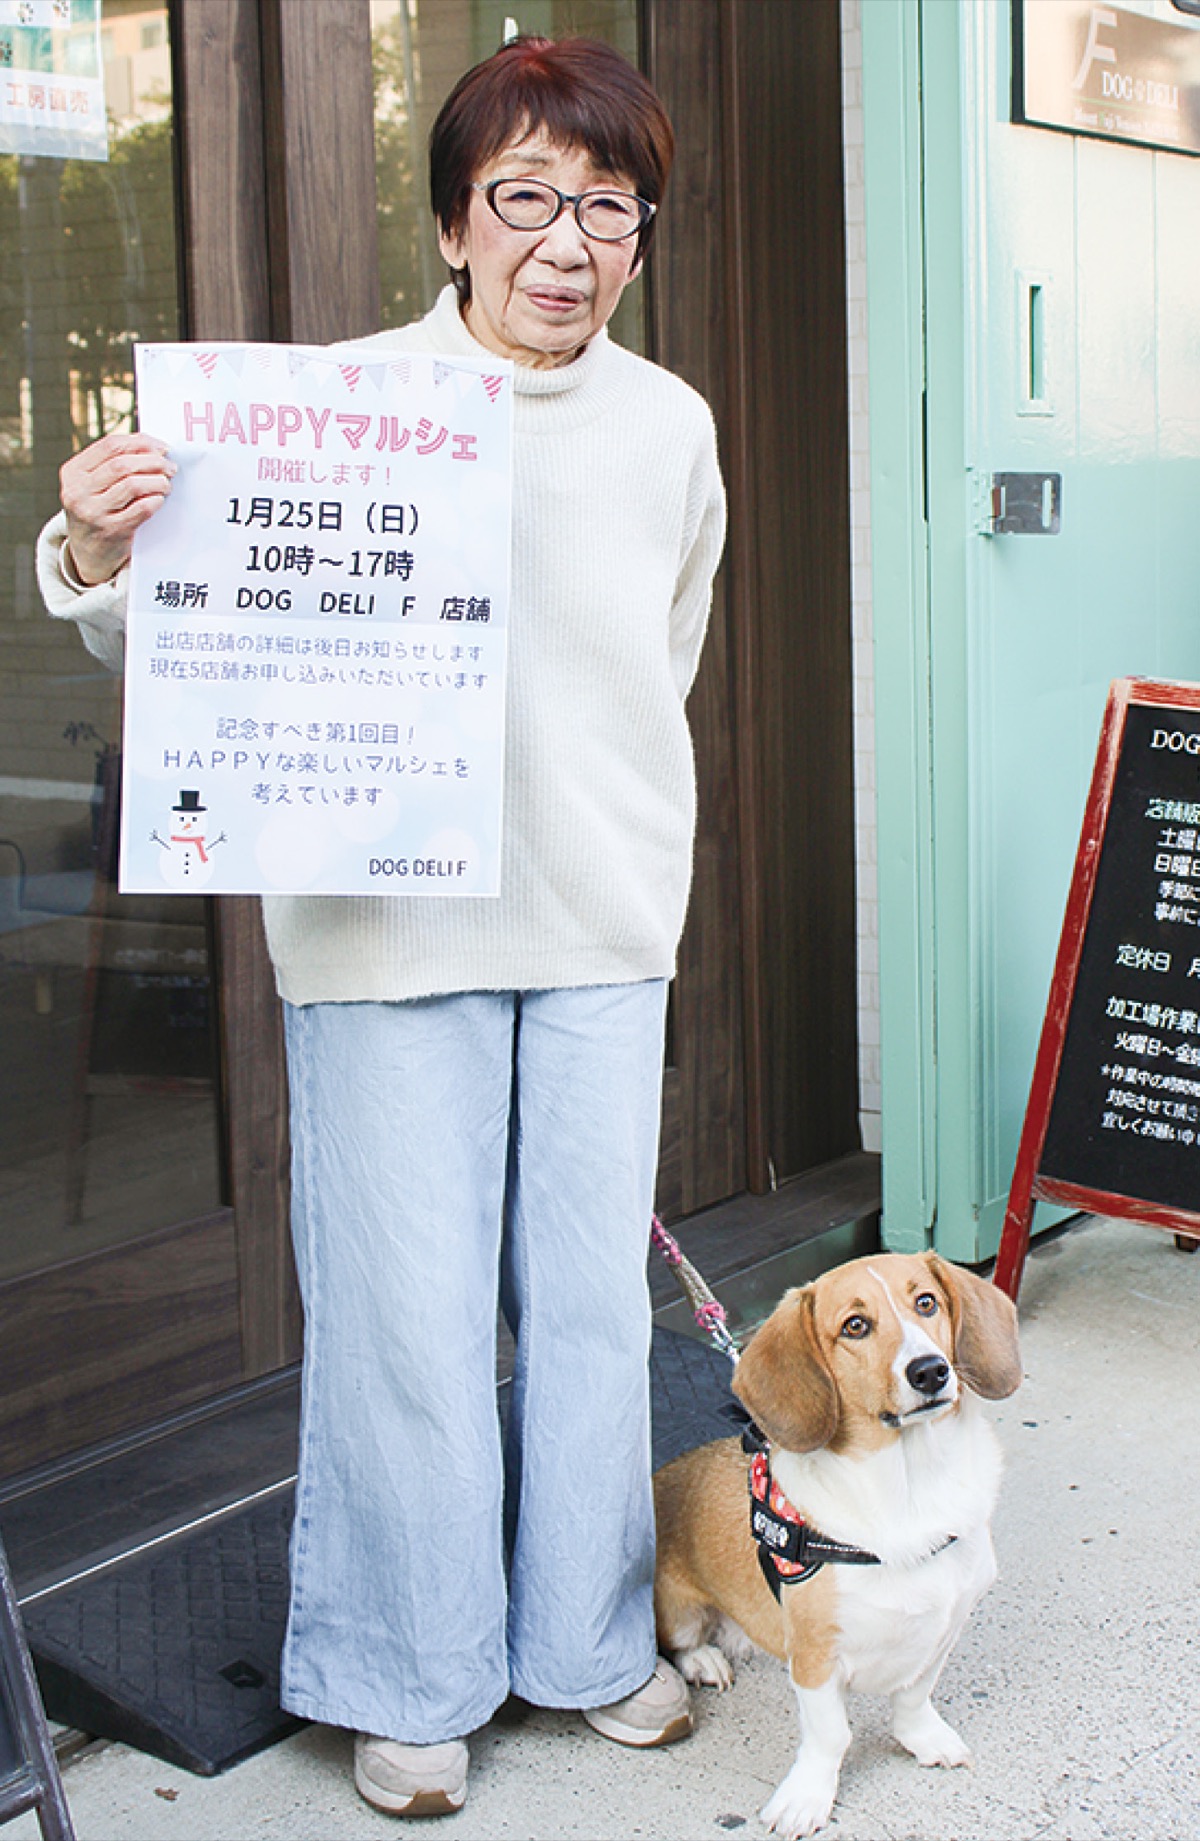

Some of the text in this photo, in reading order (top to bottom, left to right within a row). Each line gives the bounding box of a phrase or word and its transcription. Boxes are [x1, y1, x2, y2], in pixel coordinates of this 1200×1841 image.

[1102, 70, 1133, 101] DOG
[183, 401, 478, 462] HAPPYマルシェ
[257, 456, 390, 486] 開催します！
[155, 580, 491, 624] 場所 DOG DELI F 店舗
[154, 630, 484, 662] 出店店舗の詳細は後日お知らせします
[149, 656, 488, 690] 現在5店舗お申し込みいただいています
[1150, 729, 1200, 755] DOG
[251, 782, 383, 807] 考えています
[1156, 828, 1200, 851] 土曜
[369, 858, 468, 877] DOG DELI F
[1116, 944, 1171, 972] 定休日
[1106, 996, 1200, 1035] 加工場作業
